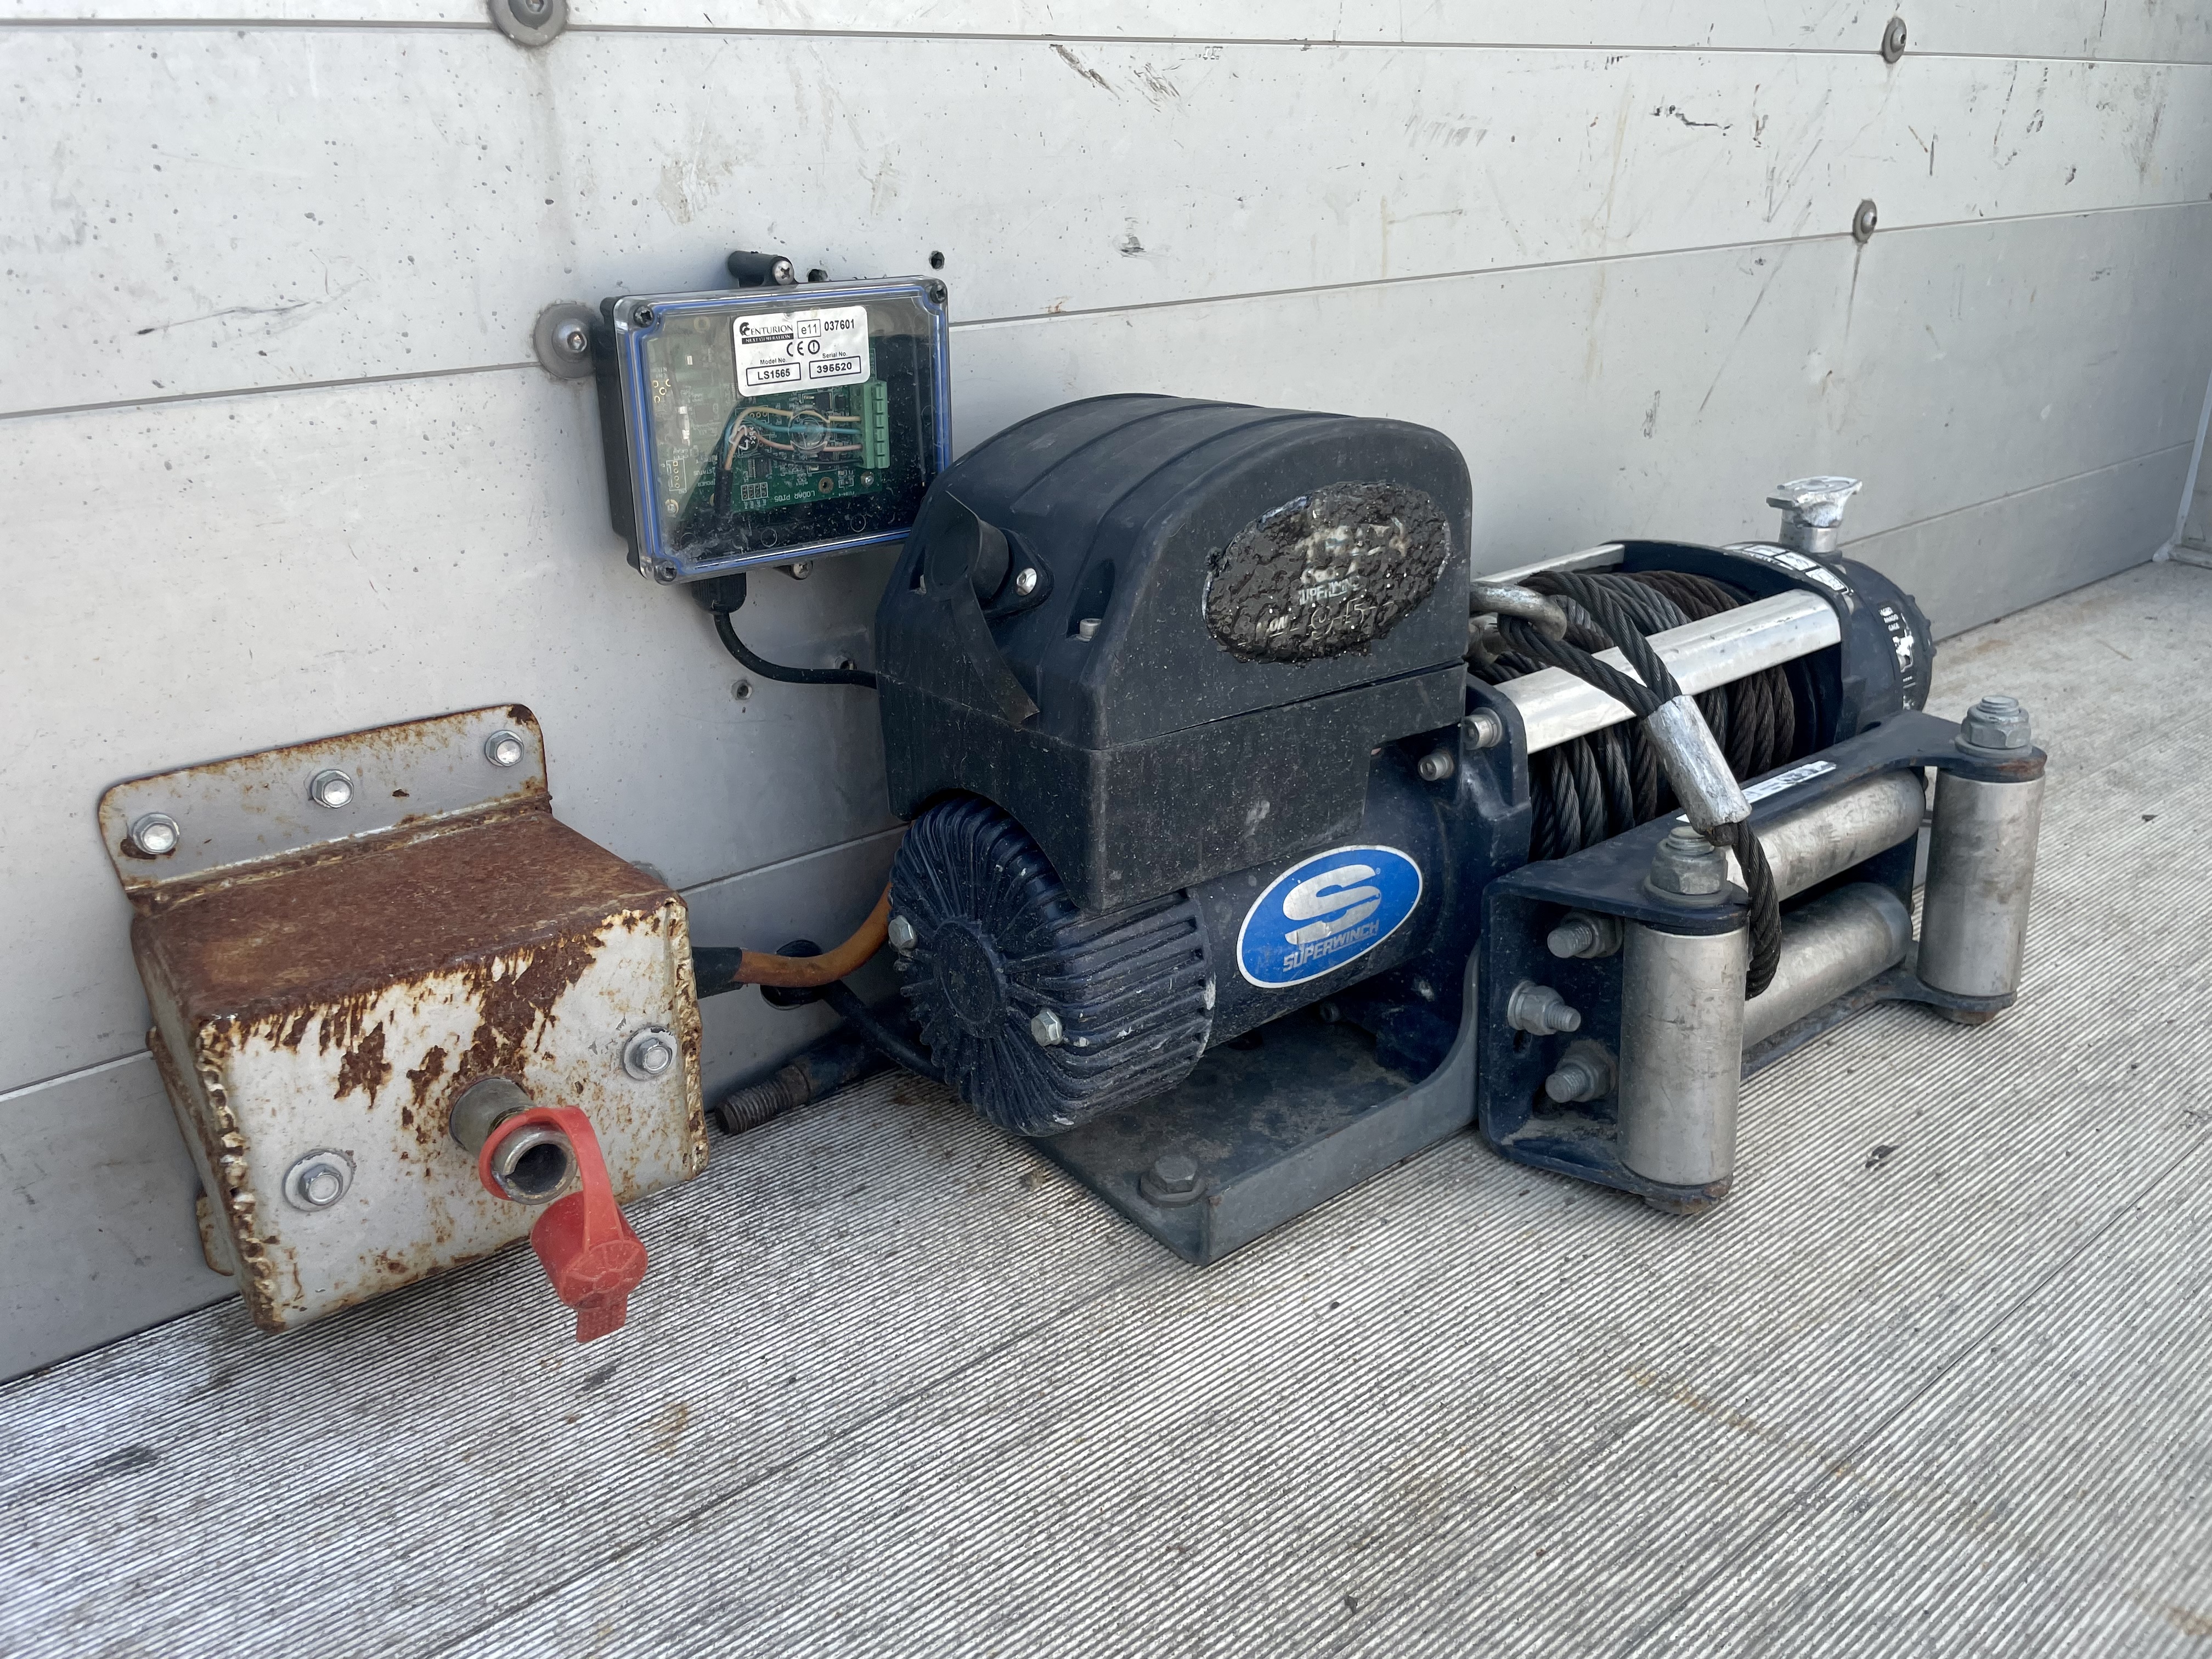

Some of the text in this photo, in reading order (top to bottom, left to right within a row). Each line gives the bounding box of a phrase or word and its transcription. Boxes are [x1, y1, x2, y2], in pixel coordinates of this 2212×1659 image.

[740, 322, 793, 336] CENTURION
[801, 324, 817, 335] e11
[824, 319, 855, 331] 037601
[757, 368, 791, 381] LS1565
[794, 490, 815, 499] LODAR
[1283, 920, 1379, 972] SUPERWINCH
